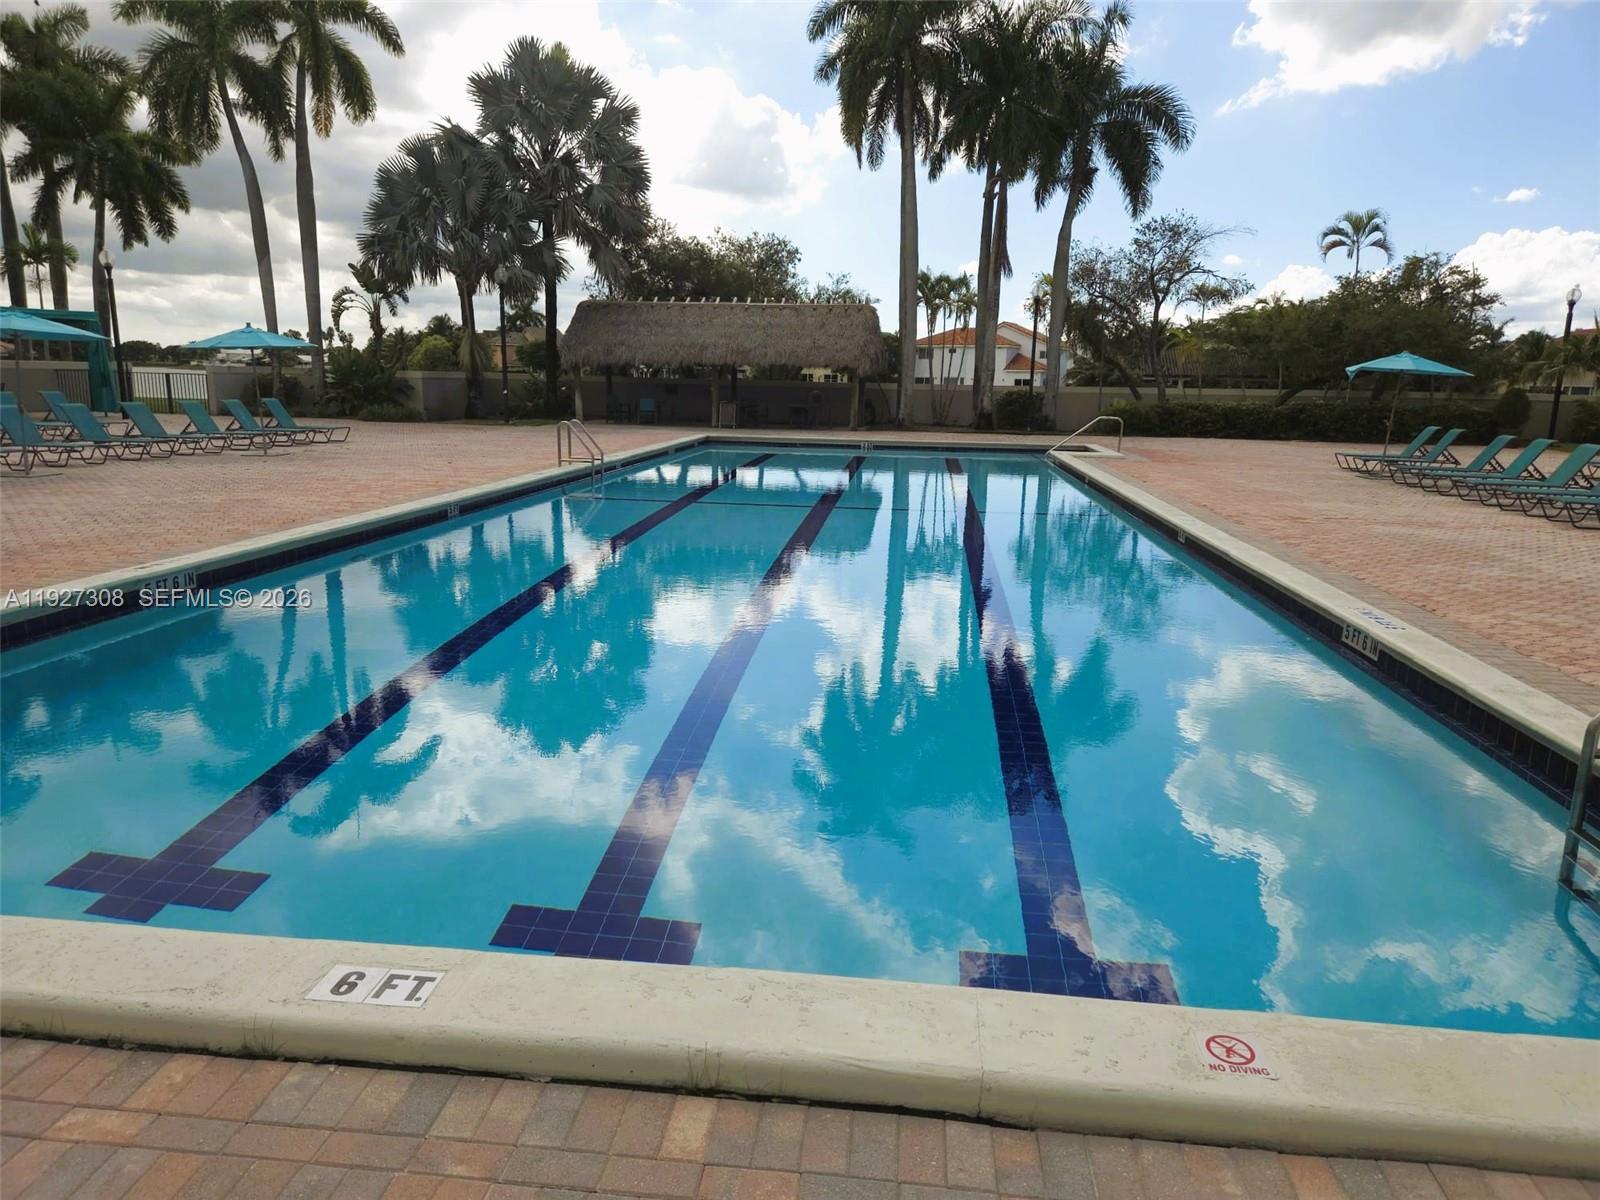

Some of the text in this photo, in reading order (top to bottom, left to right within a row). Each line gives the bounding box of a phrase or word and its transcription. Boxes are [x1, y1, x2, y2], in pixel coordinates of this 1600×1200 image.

[184, 571, 195, 588] IN
[1344, 624, 1380, 658] 5 FT 6 IN
[329, 970, 438, 1002] 6 FT.
[1208, 1063, 1271, 1077] NO DIVING
